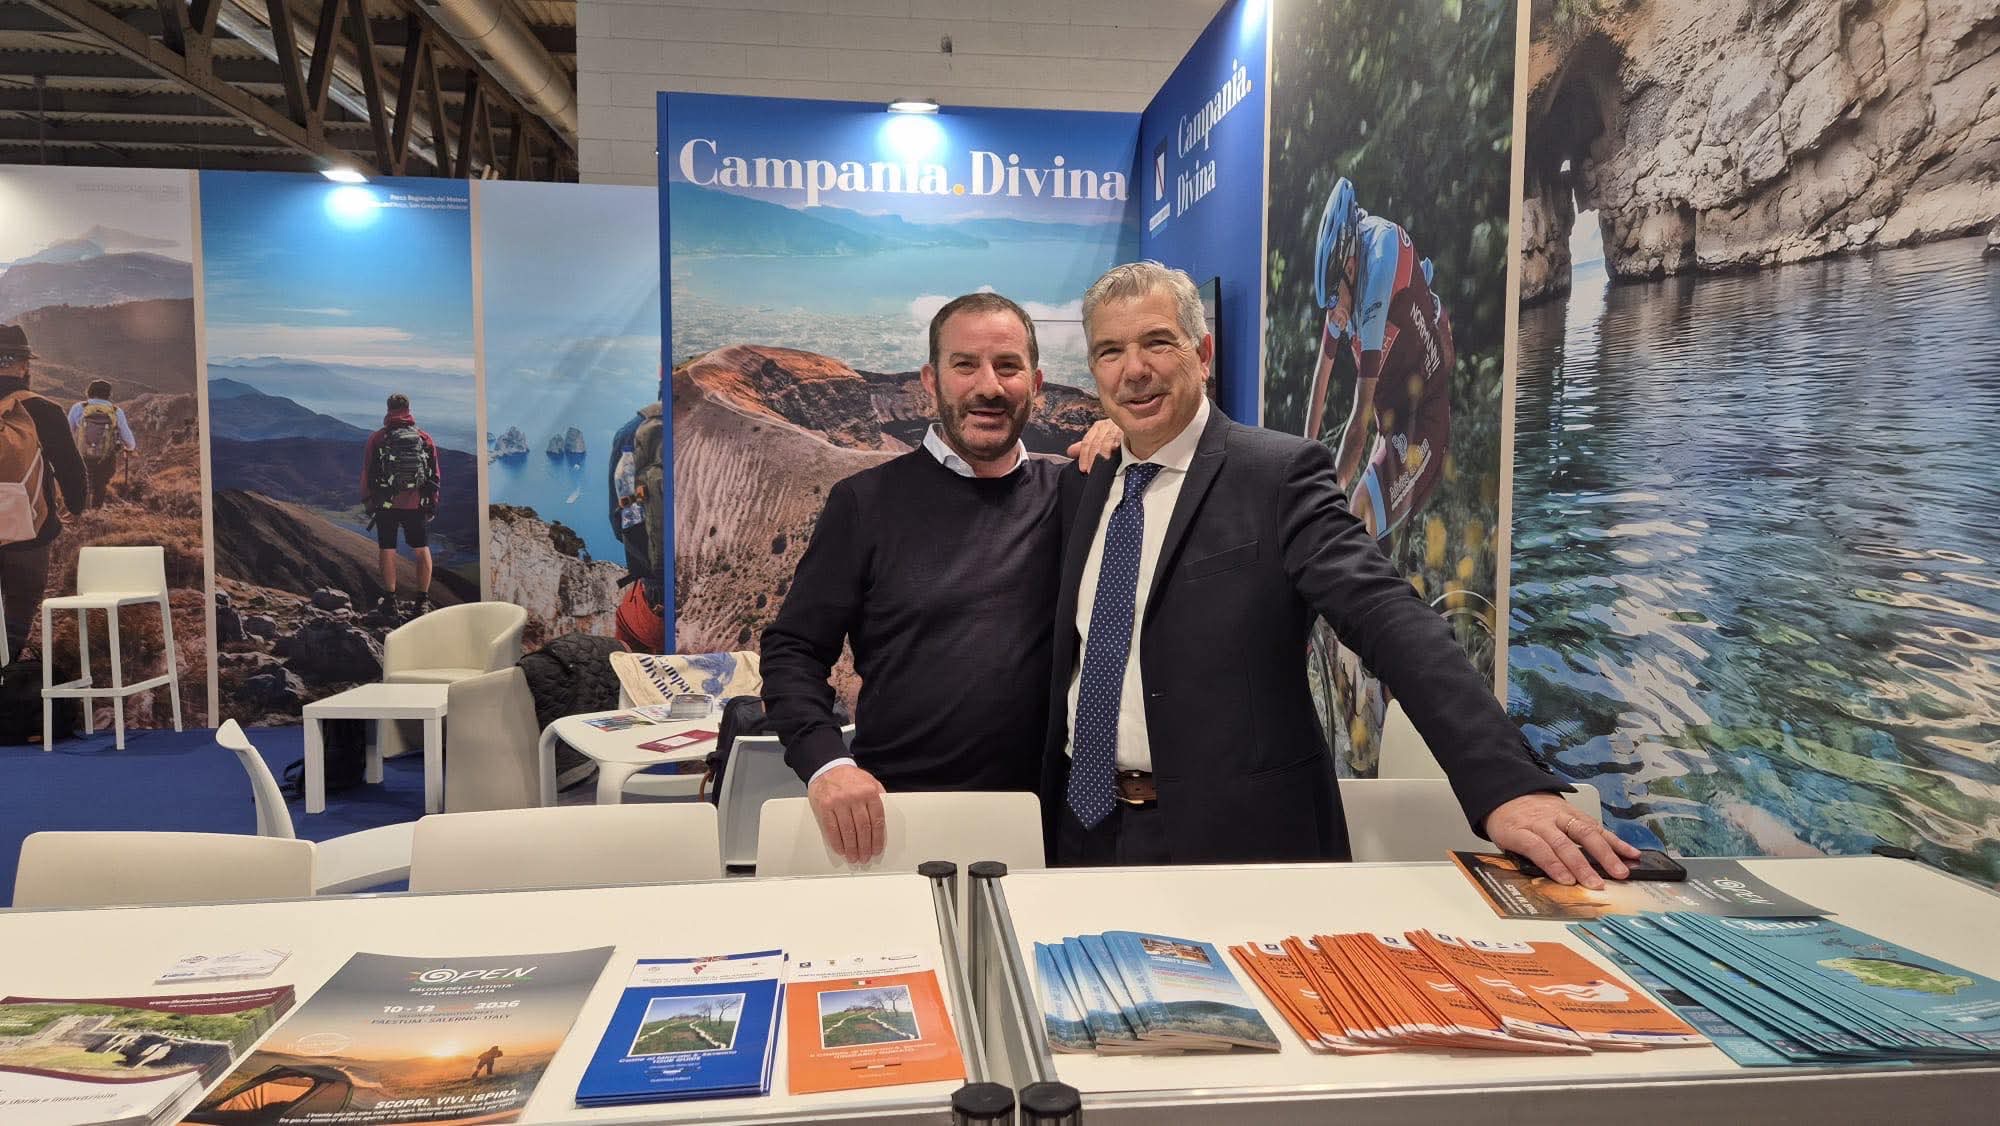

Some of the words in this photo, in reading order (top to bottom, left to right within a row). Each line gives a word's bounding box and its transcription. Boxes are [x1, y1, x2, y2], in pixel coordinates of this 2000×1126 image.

[1178, 58, 1251, 158] Campania.
[1177, 159, 1216, 218] Divina
[639, 655, 674, 700] Divina
[419, 965, 538, 983] OPEN
[383, 1005, 403, 1013] 10
[415, 1004, 436, 1013] 12
[473, 1000, 521, 1010] 2026
[374, 1098, 431, 1109] SCOPRI.
[470, 1088, 520, 1102] ISPIRA.
